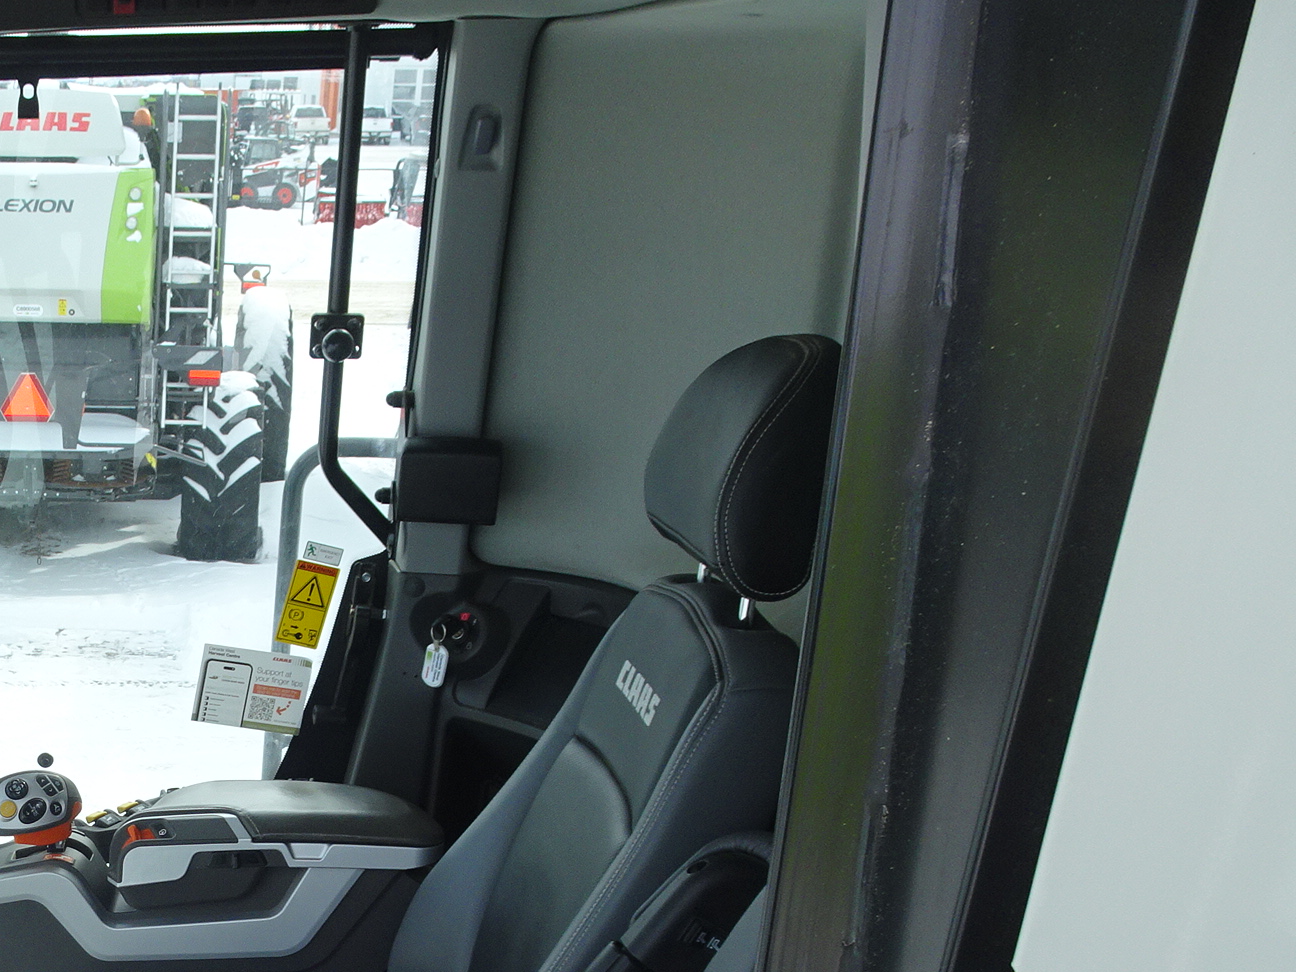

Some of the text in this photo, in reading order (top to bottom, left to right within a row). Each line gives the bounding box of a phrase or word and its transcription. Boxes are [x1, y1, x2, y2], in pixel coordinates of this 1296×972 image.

[256, 666, 284, 678] Support
[255, 675, 270, 684] your
[271, 676, 290, 685] finger
[291, 679, 304, 688] tips
[615, 659, 661, 727] CLAAS
